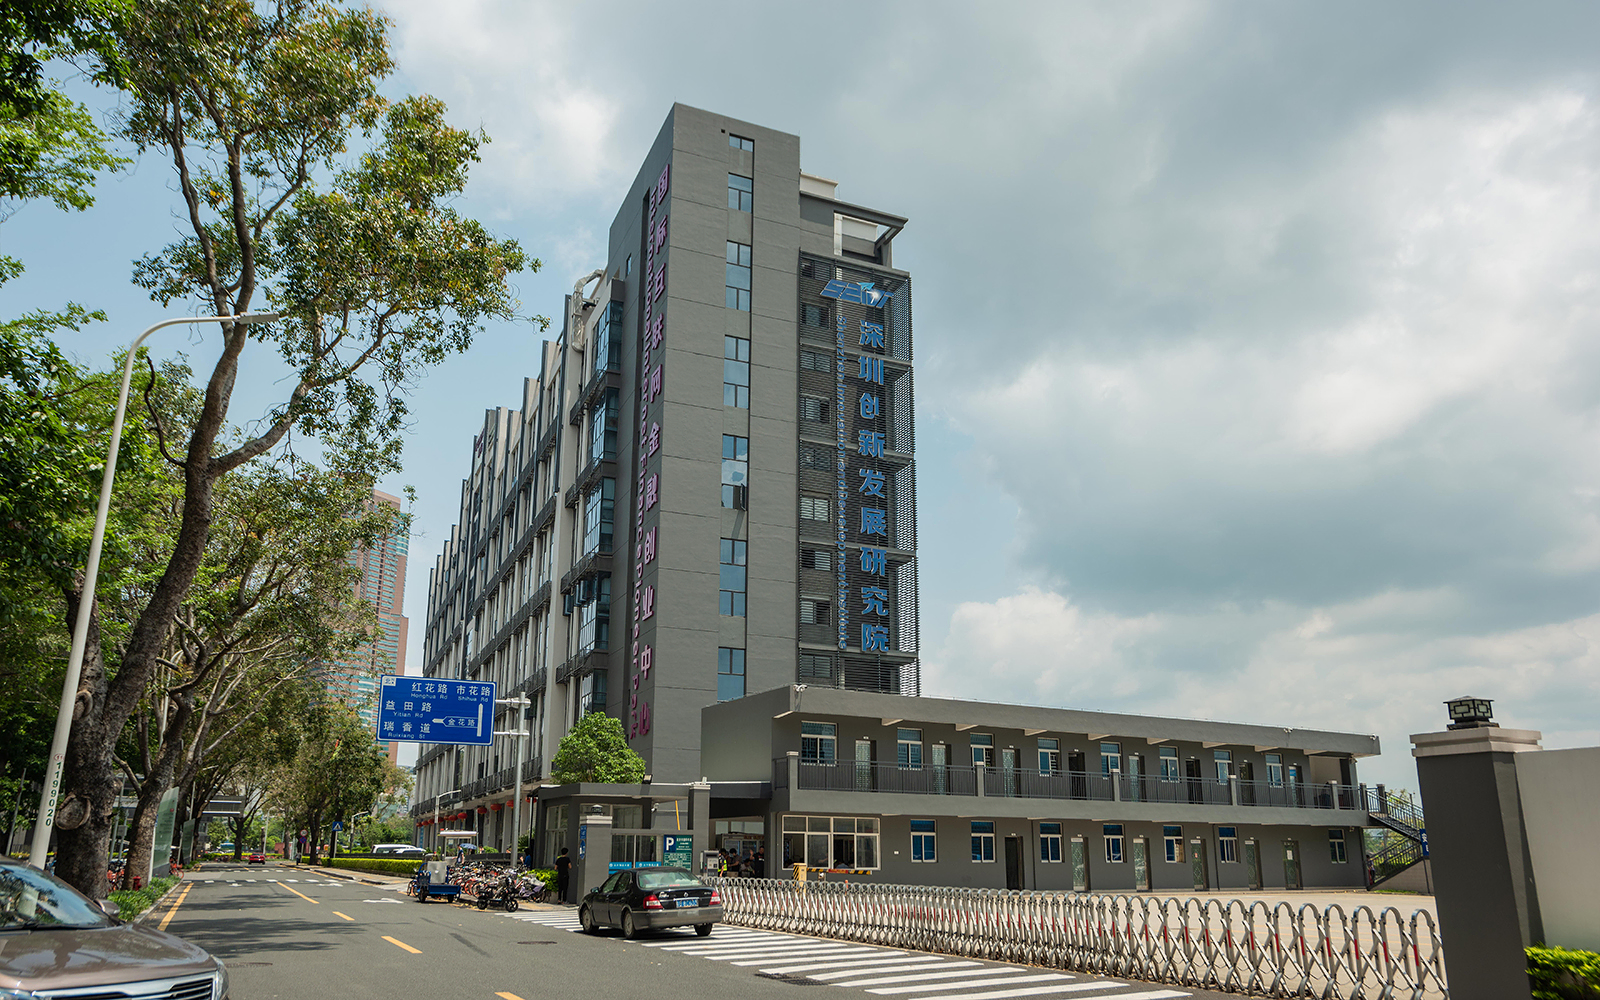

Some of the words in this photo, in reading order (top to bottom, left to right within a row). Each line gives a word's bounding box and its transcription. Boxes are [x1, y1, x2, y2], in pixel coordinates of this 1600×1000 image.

[645, 186, 658, 341] International
[837, 315, 847, 379] Shenzhen
[640, 341, 651, 448] Internet
[837, 383, 847, 458] Innovation
[639, 163, 670, 736] 国际互联网金融创业中心
[838, 460, 848, 489] and
[636, 453, 647, 559] Finance
[858, 319, 889, 653] 深圳创新发展研究院
[835, 490, 848, 587] Development
[632, 564, 642, 668] Pioneer
[838, 588, 849, 650] Institute
[384, 700, 432, 713] 益田路
[411, 682, 448, 694] 红花路
[456, 685, 491, 697] 市花路
[630, 674, 639, 740] Park
[383, 721, 431, 734] 瑞香道
[448, 717, 476, 727] 金花路
[45, 761, 62, 827] 1199020
[666, 837, 675, 851] P
